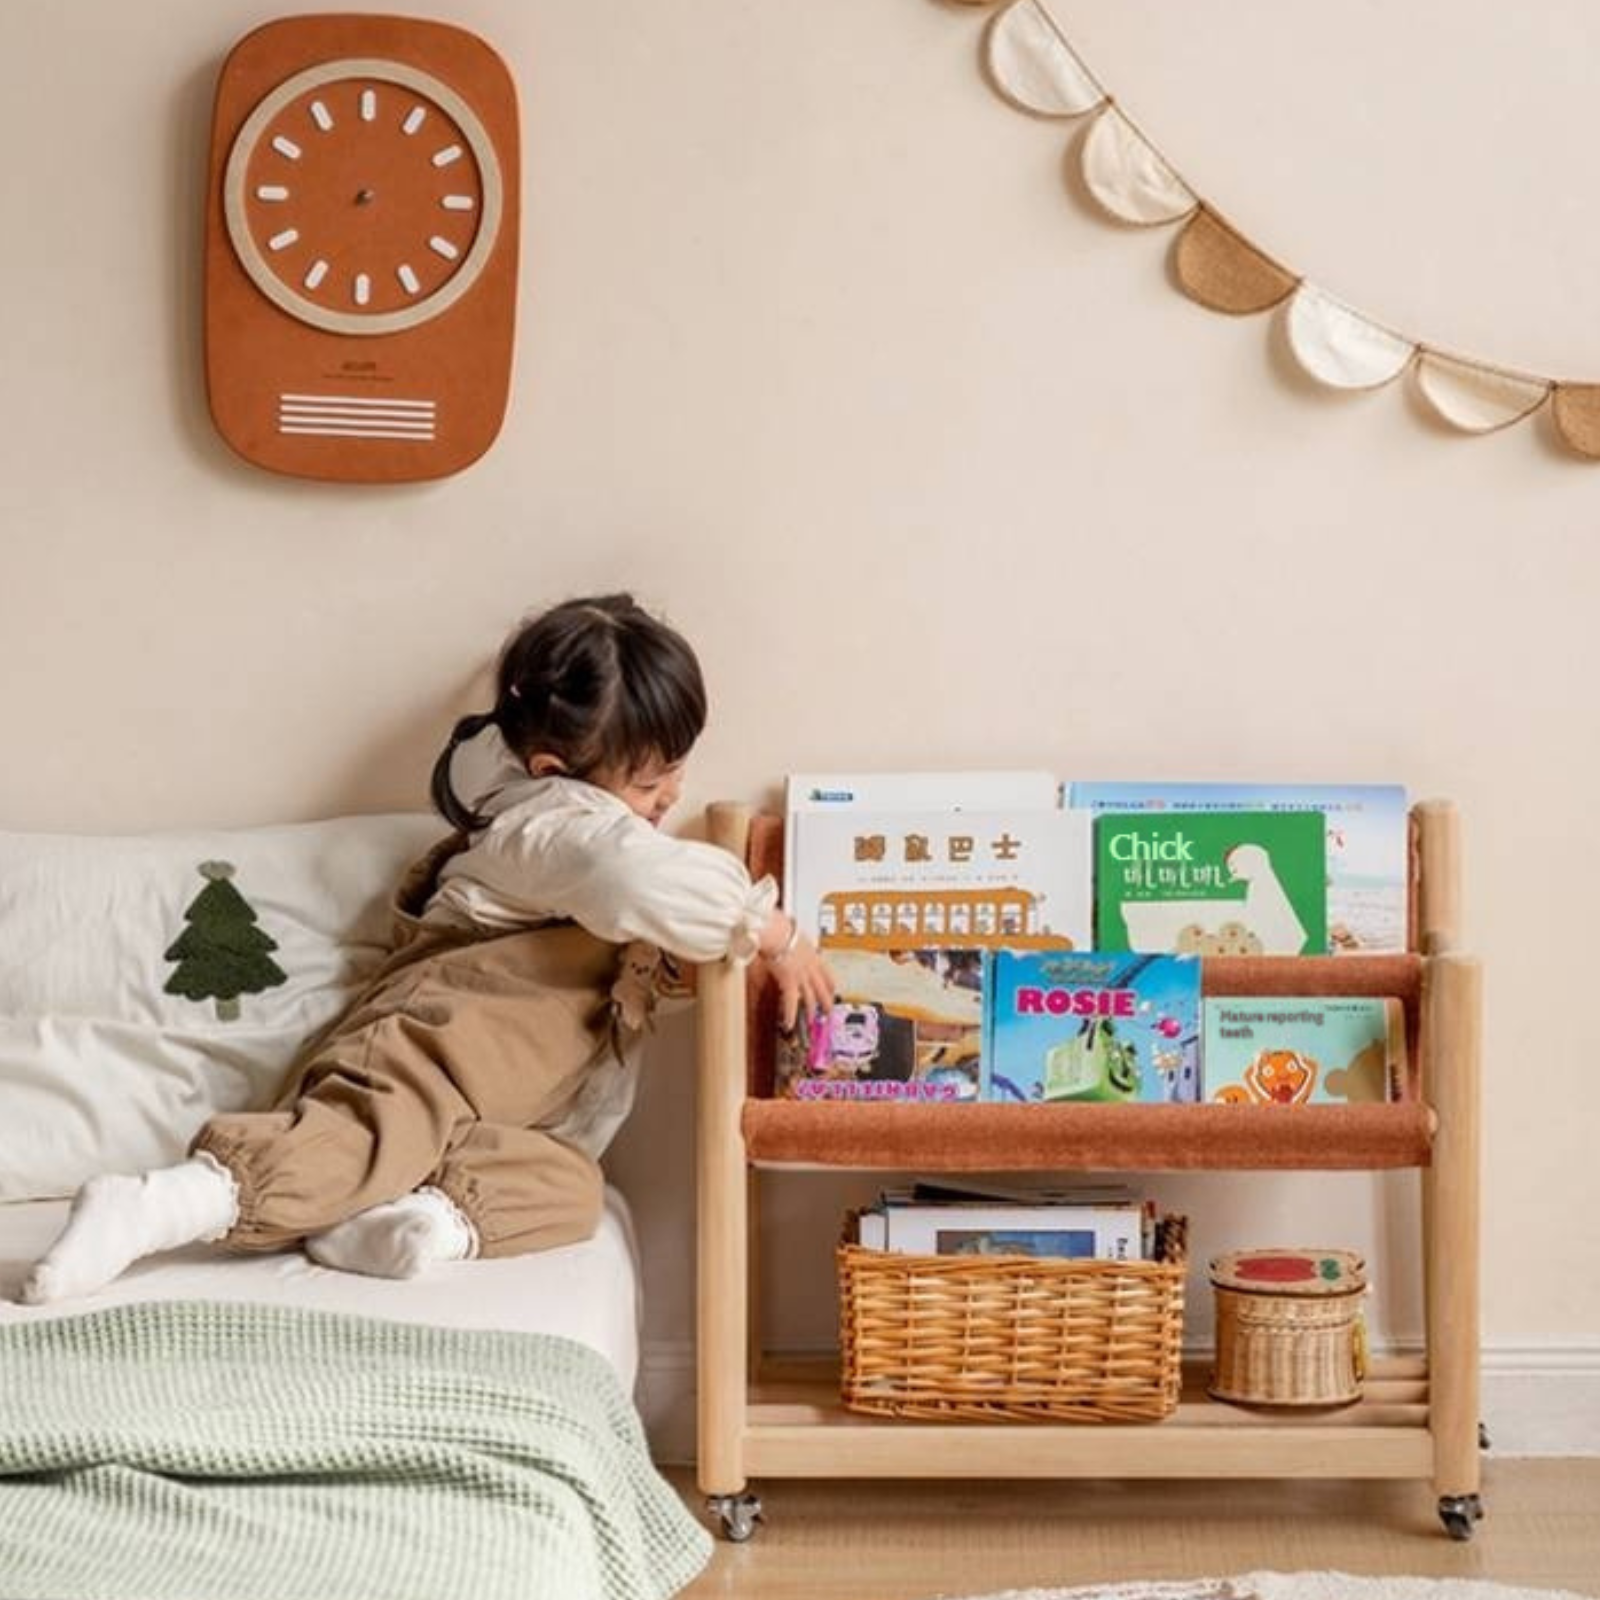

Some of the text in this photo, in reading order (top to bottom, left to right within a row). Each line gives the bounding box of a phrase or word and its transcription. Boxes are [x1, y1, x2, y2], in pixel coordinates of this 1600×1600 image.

[1109, 832, 1194, 860] Chick
[1015, 986, 1137, 1017] ROSIE
[1266, 1008, 1324, 1027] reporting
[1219, 1026, 1254, 1039] teeth
